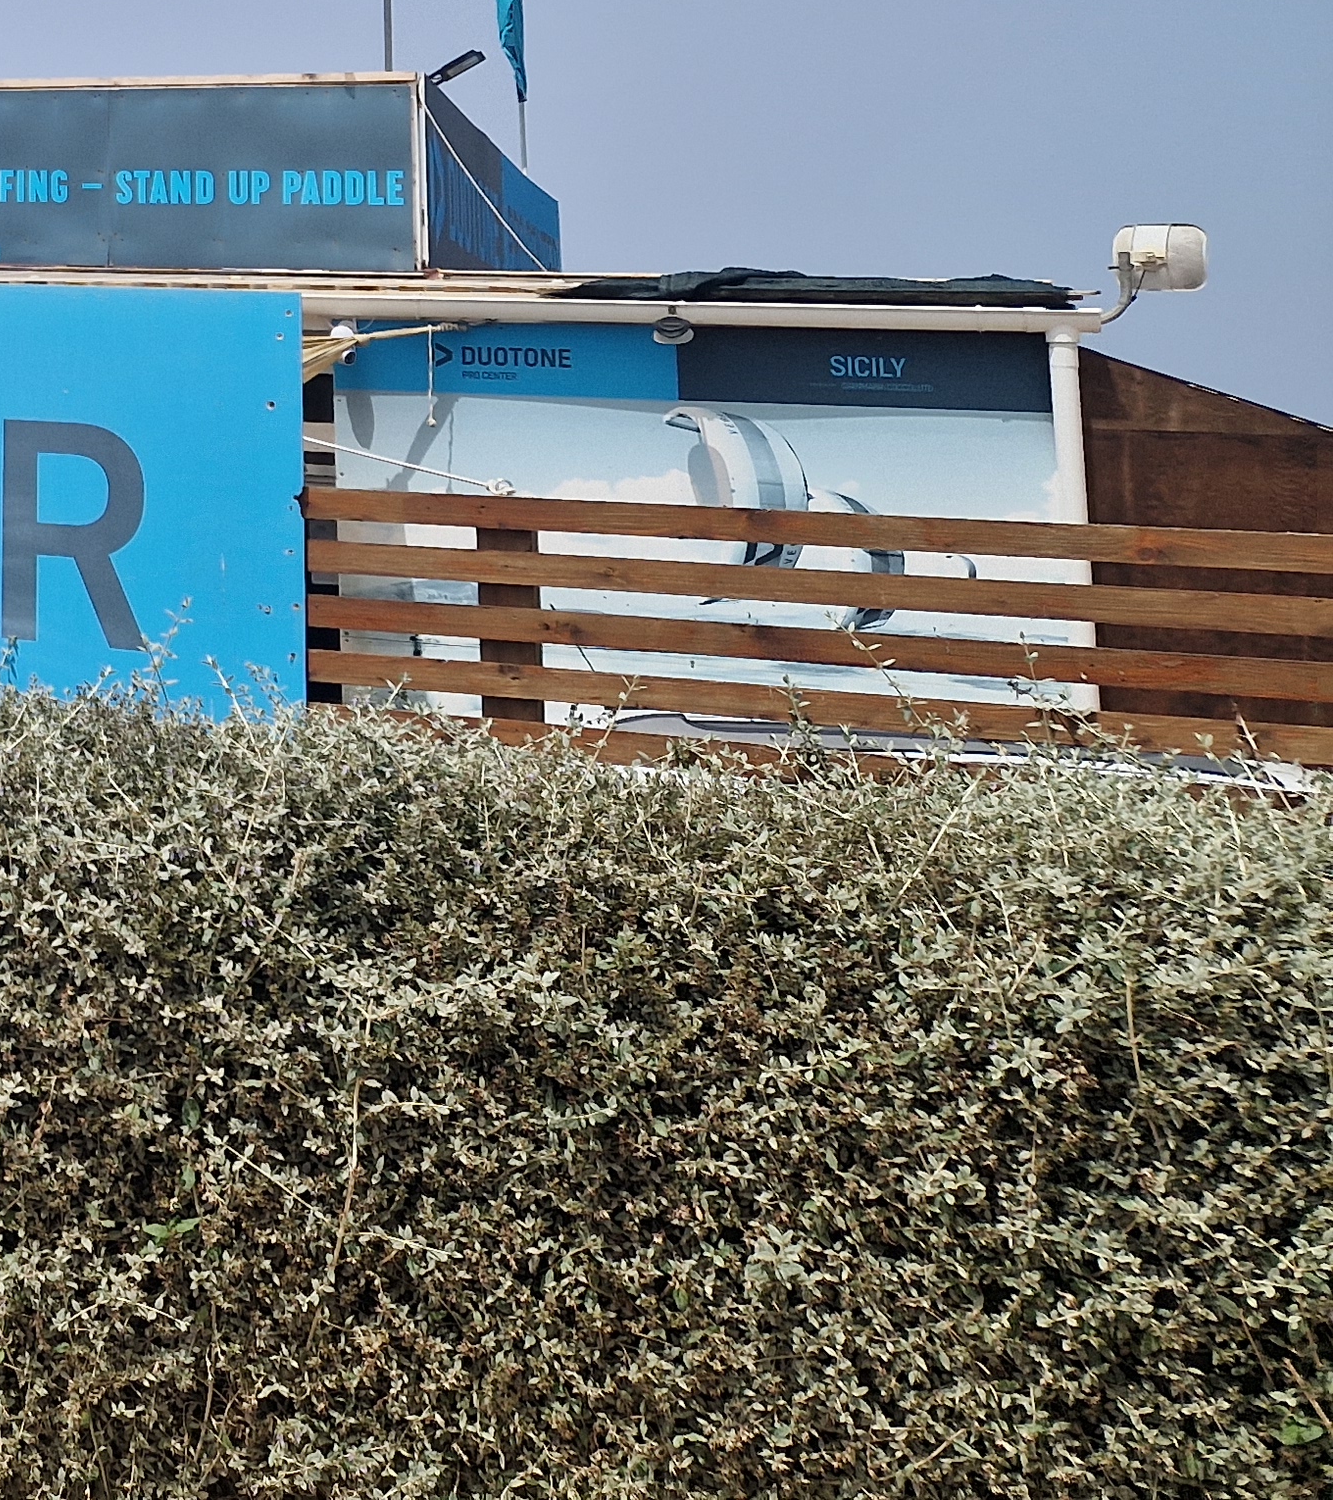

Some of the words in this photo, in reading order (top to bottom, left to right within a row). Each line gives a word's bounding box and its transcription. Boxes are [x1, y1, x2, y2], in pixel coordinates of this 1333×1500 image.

[115, 169, 216, 206] STAND
[227, 170, 271, 206] UP
[282, 169, 406, 207] PADDLE
[461, 346, 572, 368] DUOTONE
[829, 355, 907, 378] SICILY
[462, 371, 480, 380] PRO
[481, 371, 518, 381] CENTER
